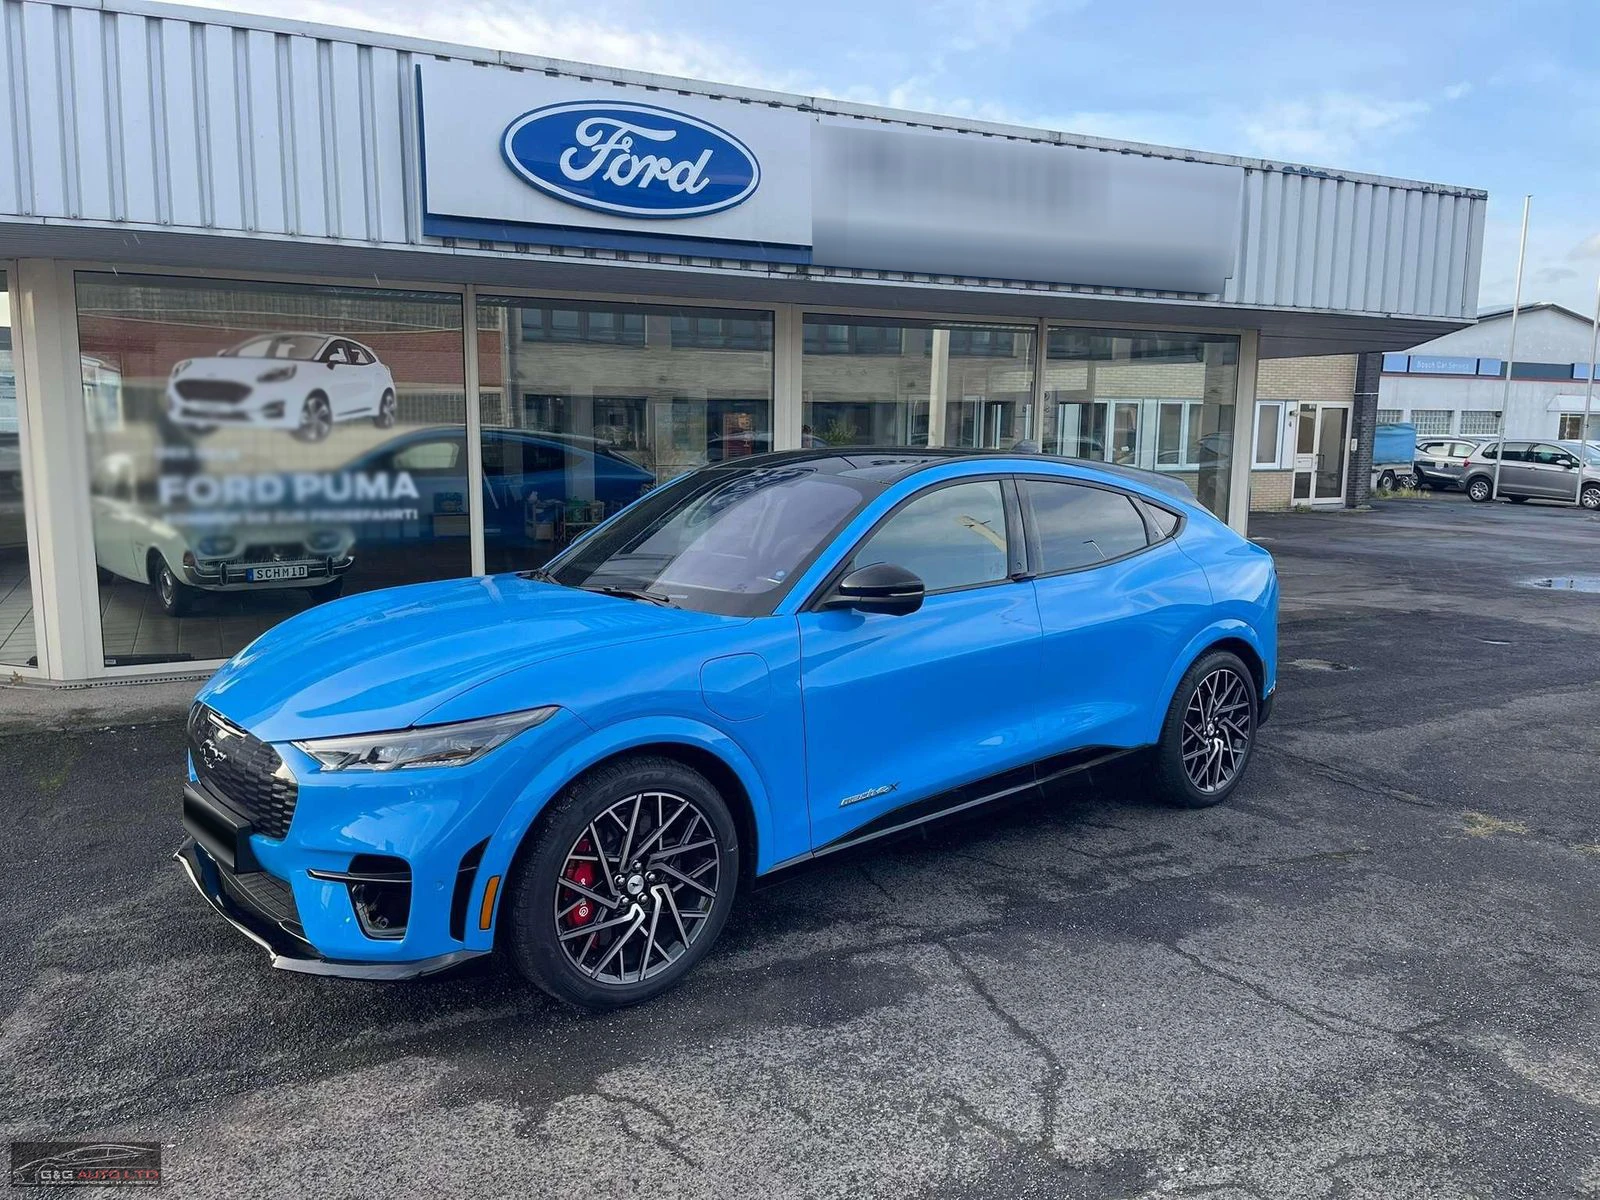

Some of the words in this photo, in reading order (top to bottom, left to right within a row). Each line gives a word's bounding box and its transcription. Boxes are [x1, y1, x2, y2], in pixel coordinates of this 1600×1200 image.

[559, 116, 714, 195] Ford
[158, 473, 286, 504] FORD
[294, 470, 420, 501] PUMA
